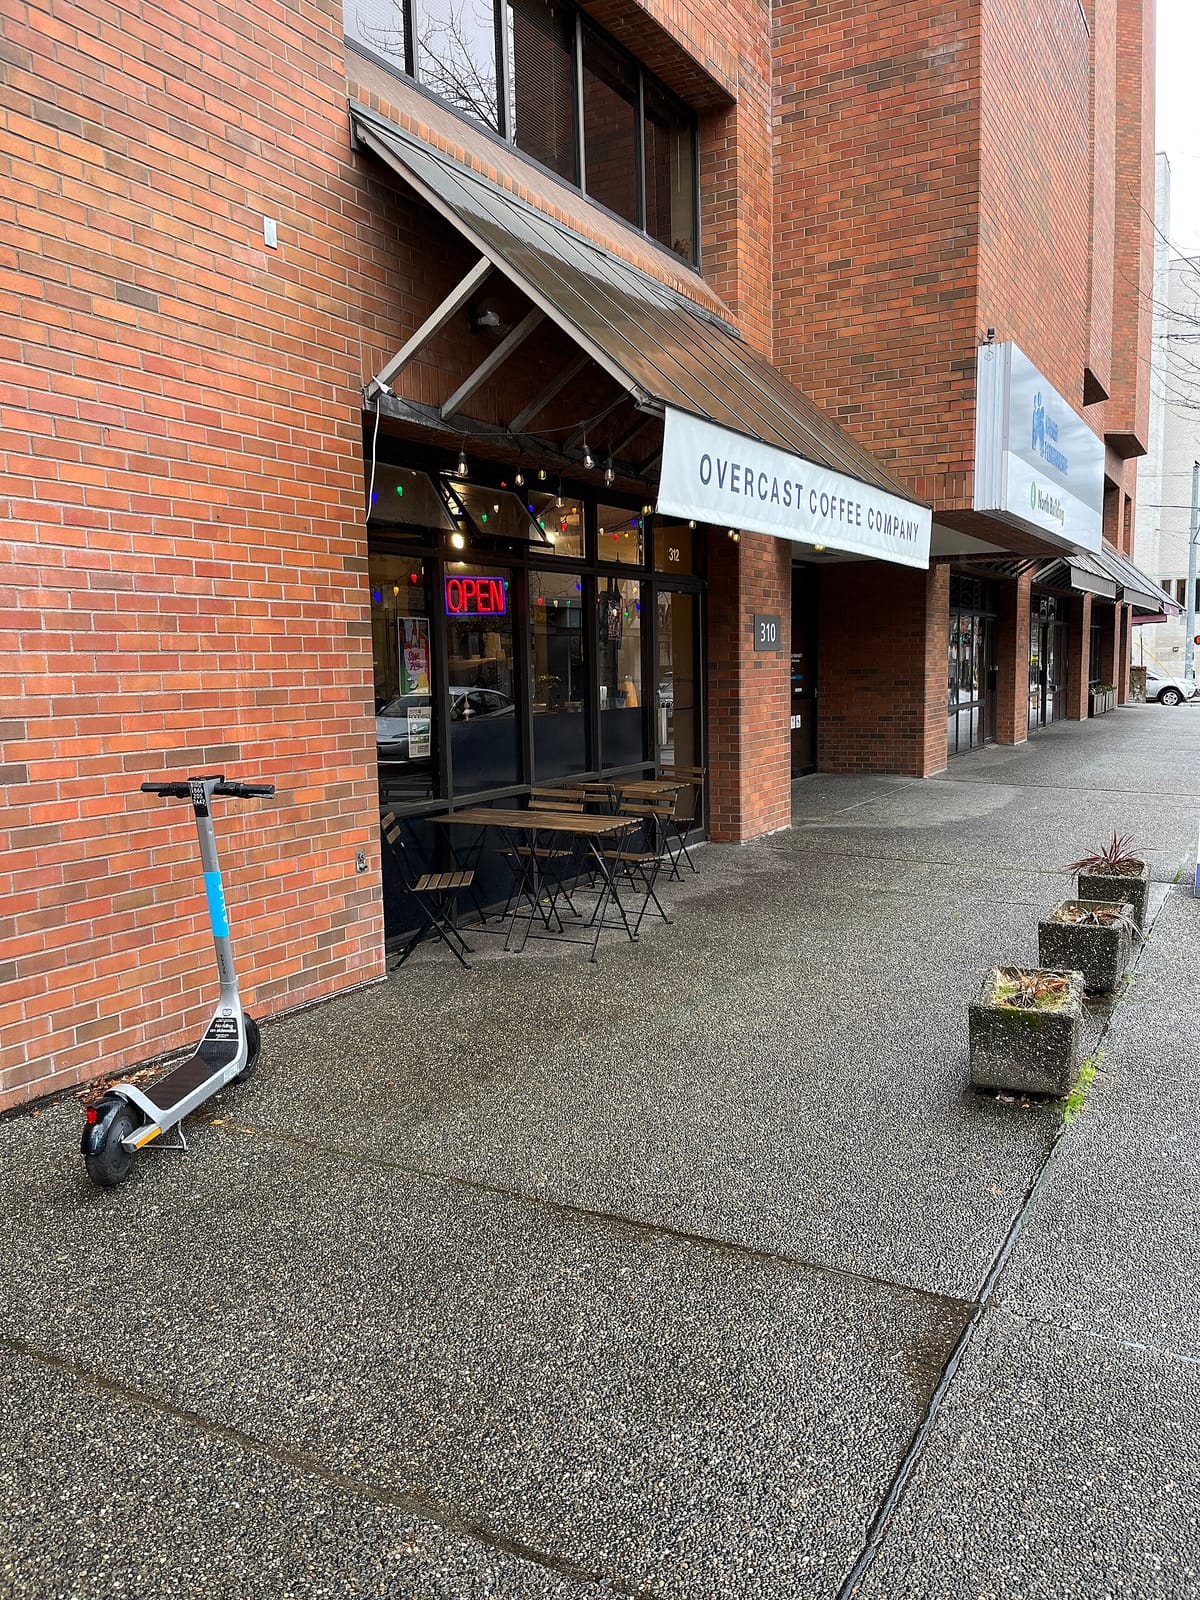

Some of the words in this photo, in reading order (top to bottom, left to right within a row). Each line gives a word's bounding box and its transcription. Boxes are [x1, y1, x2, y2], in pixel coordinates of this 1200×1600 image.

[700, 454, 803, 509] OVERCAST
[809, 489, 862, 526] COFFEE
[867, 507, 919, 543] COMPANY
[668, 547, 680, 562] 312
[446, 578, 505, 613] OPEN
[760, 622, 776, 642] 310
